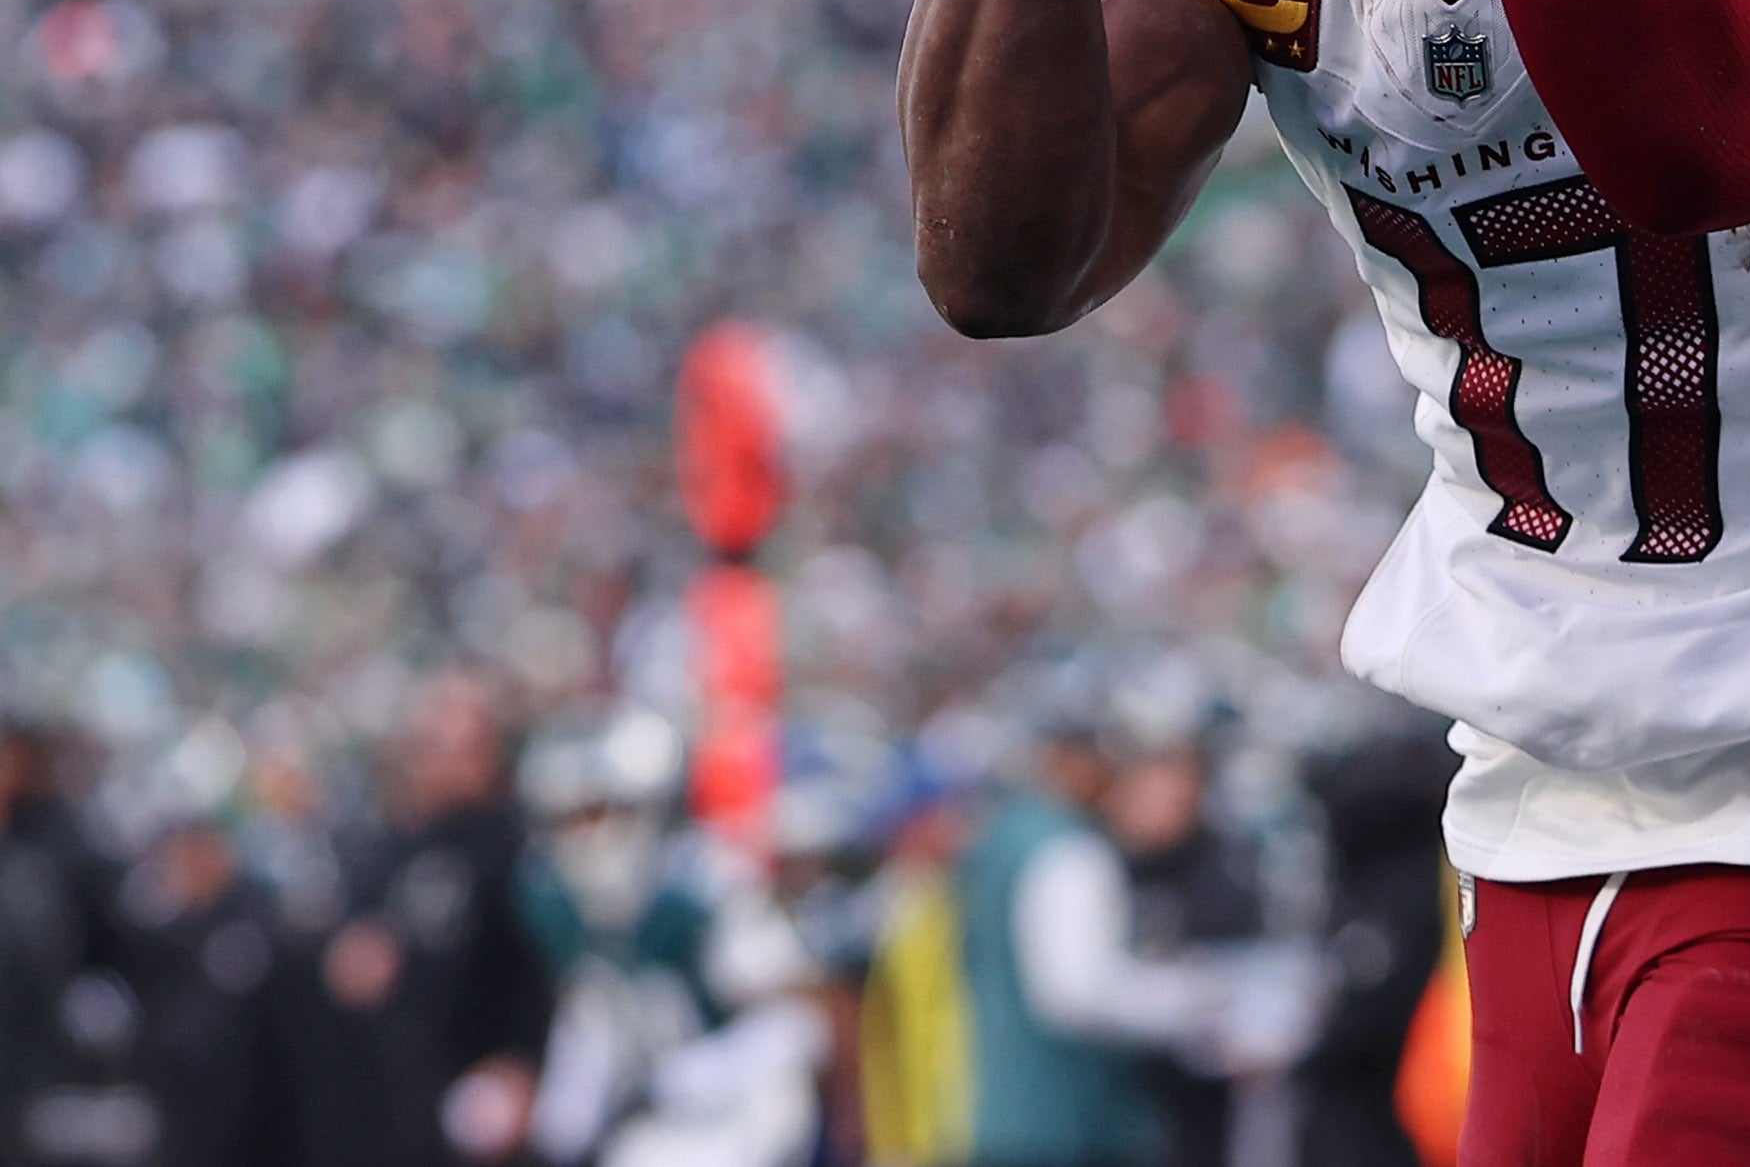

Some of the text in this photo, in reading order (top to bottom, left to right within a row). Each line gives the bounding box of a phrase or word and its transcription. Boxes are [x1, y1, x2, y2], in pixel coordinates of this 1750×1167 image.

[1435, 64, 1482, 92] NFL
[1317, 127, 1557, 194] WASHING
[1340, 172, 1724, 564] 17
